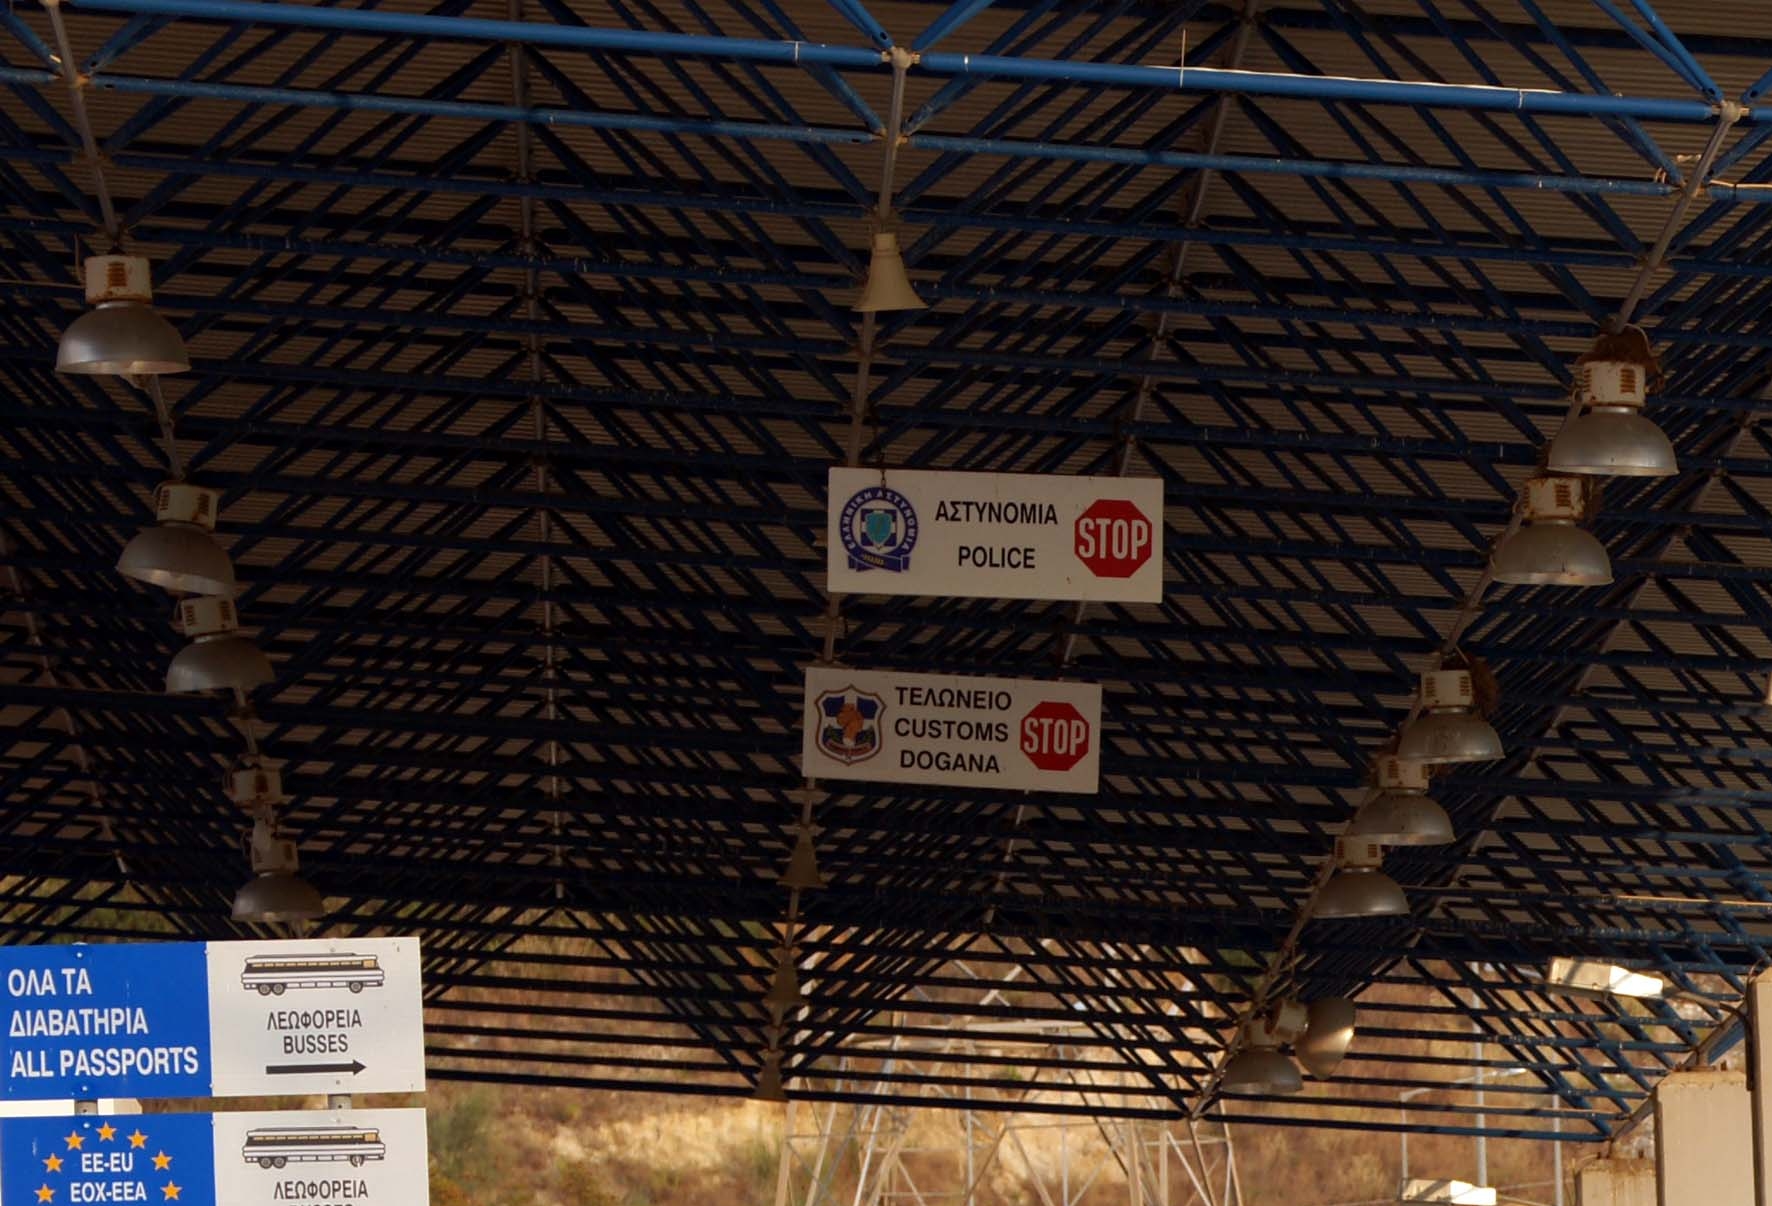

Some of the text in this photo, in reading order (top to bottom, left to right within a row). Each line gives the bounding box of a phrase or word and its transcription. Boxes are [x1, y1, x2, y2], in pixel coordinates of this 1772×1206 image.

[935, 500, 1058, 525] ΑΣΤΥΝΟΜΙΑ
[1078, 518, 1148, 560] STOP
[957, 546, 1036, 568] POLICE
[896, 686, 1012, 711] ΤΕΛΩΝΕΙΟ
[894, 717, 1009, 742] CUSTOMS
[1024, 721, 1086, 756] STOP
[900, 749, 1000, 774] DOGANA
[8, 968, 92, 996] ΟΛΑ ΤΑ
[9, 1008, 149, 1037] ΔΙΑΒΑΤΗΡΙΑ
[267, 1009, 362, 1031] ΛΕΩΦΟΡΕΙΑ
[283, 1034, 348, 1054] BUSSES
[11, 1047, 198, 1078] ALL PASSPORTS
[81, 1152, 134, 1173] ΕΕ-EU
[70, 1182, 147, 1202] ΕΟΧ-EEA
[273, 1180, 368, 1200] ΛΕΩΦΟΡΕΙΑ
